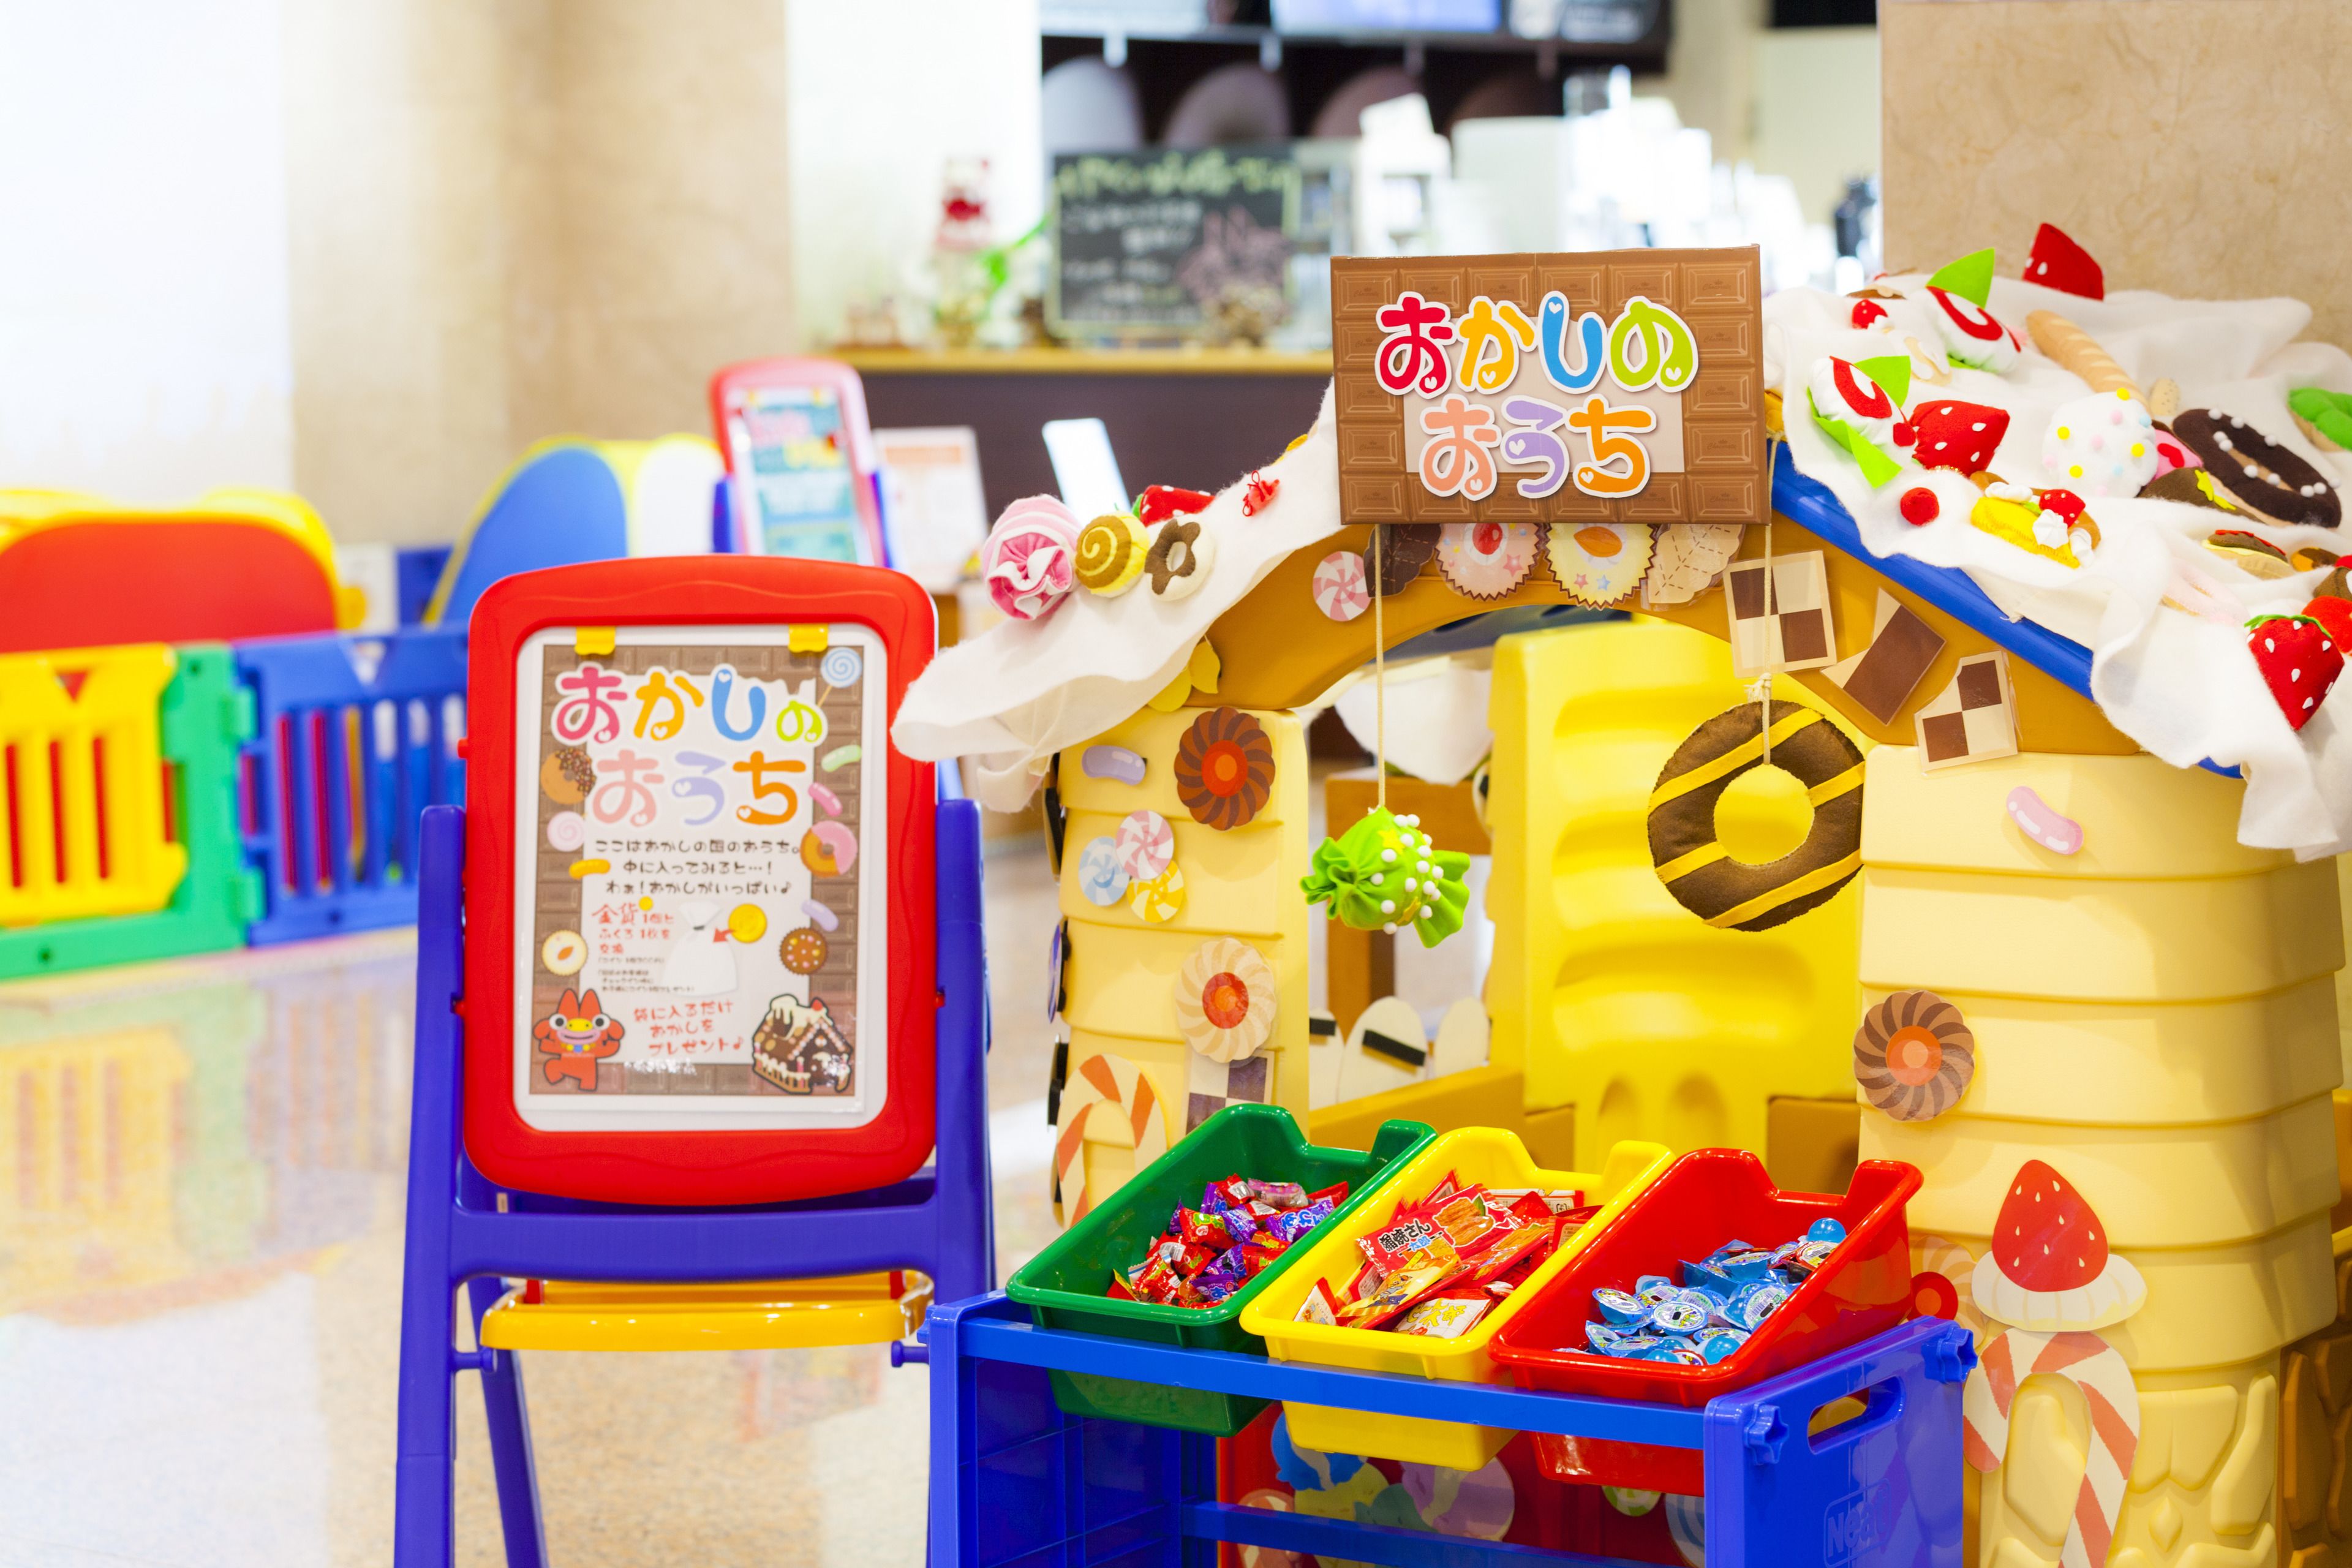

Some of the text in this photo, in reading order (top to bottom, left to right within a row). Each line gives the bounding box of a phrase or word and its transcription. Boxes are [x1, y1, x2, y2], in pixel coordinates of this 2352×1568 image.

[1378, 293, 1695, 396] おかしの
[1421, 396, 1654, 497] おうち
[556, 665, 824, 744] おかしの
[592, 748, 807, 827] おうち
[595, 839, 800, 854] ここはおかしの国のおうち。
[649, 1018, 715, 1039] おかしを
[1378, 1219, 1431, 1252] 蒲焼さん
[1409, 1235, 1431, 1251] 太郎
